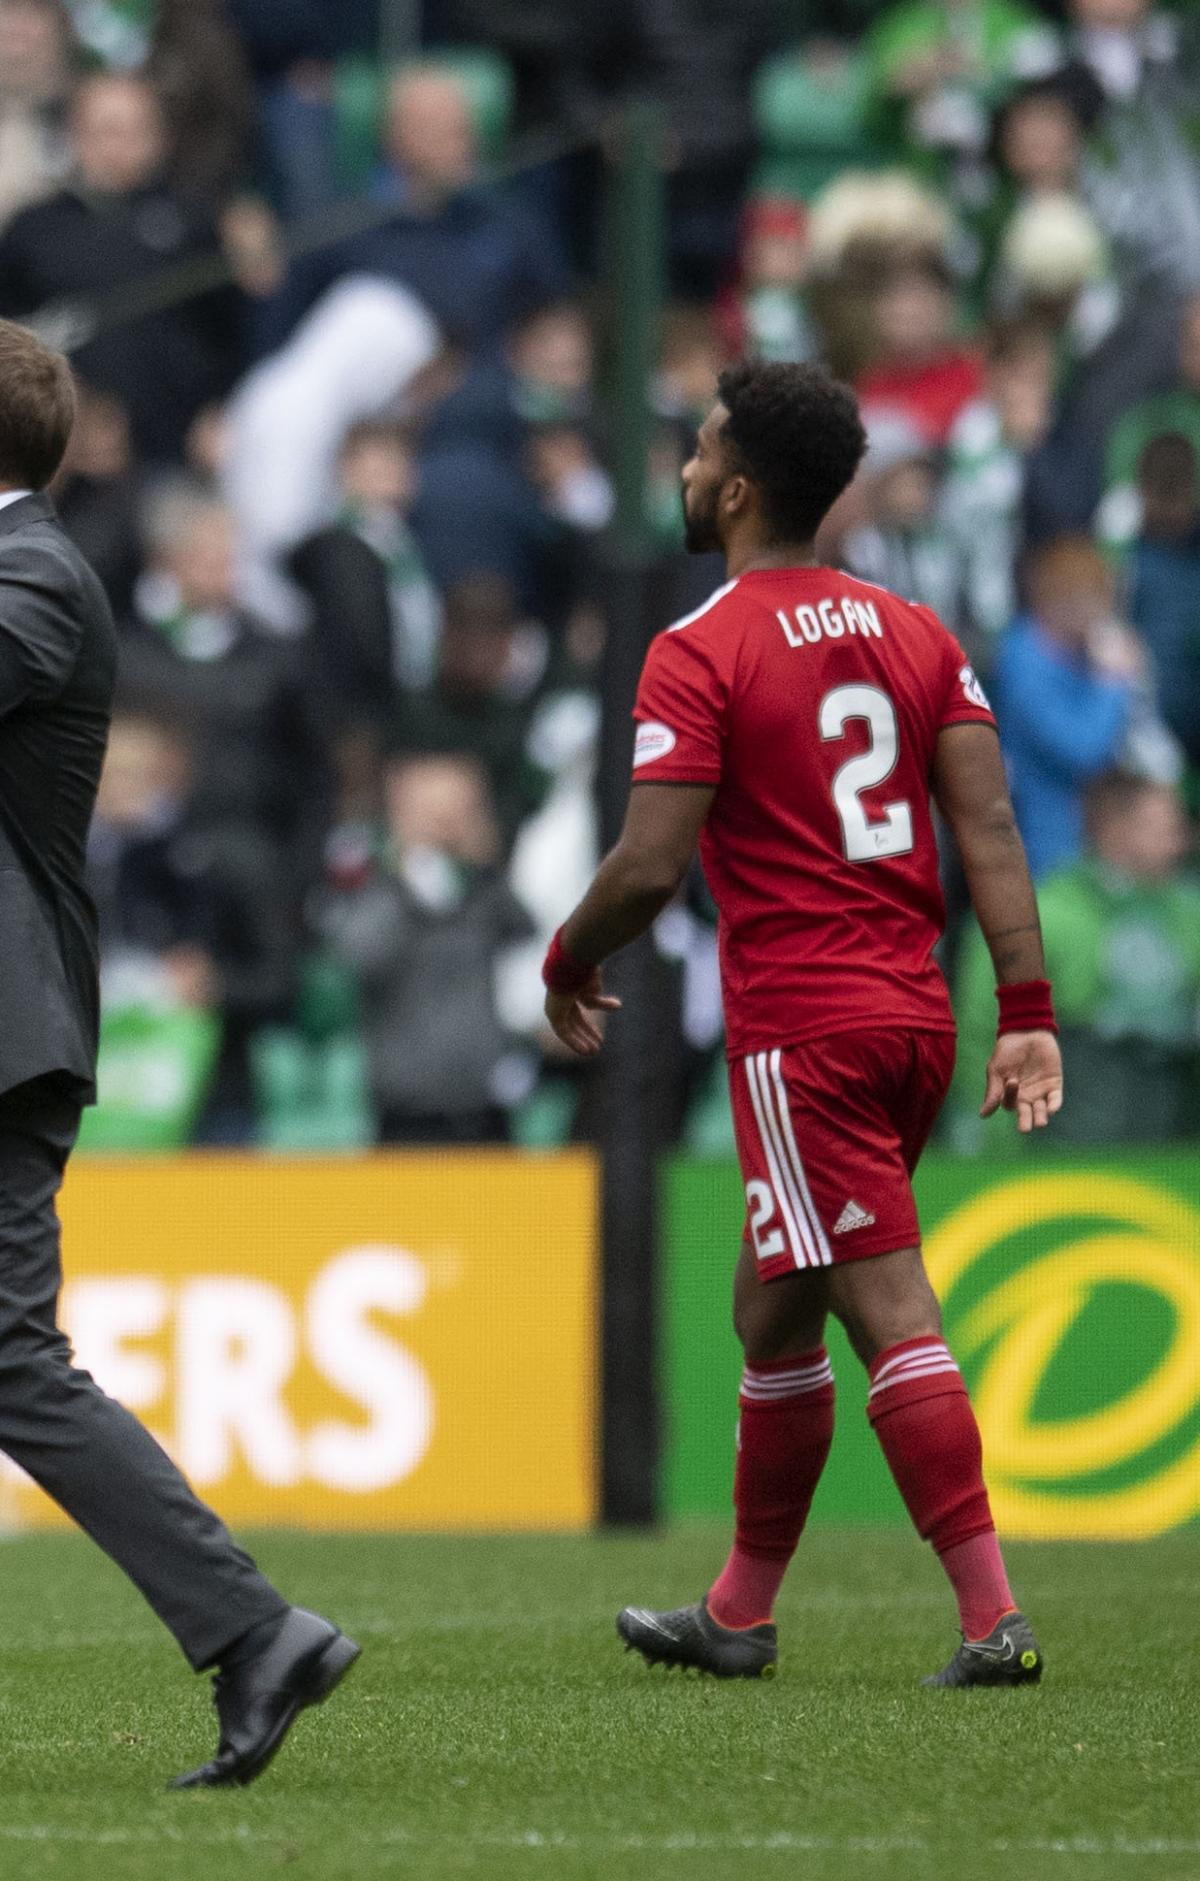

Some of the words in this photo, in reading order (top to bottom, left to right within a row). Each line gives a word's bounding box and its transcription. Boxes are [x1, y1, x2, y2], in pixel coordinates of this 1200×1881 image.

[775, 597, 883, 648] LOGAN
[819, 681, 915, 864] 2
[745, 1178, 785, 1260] 2
[833, 1215, 876, 1234] adidas
